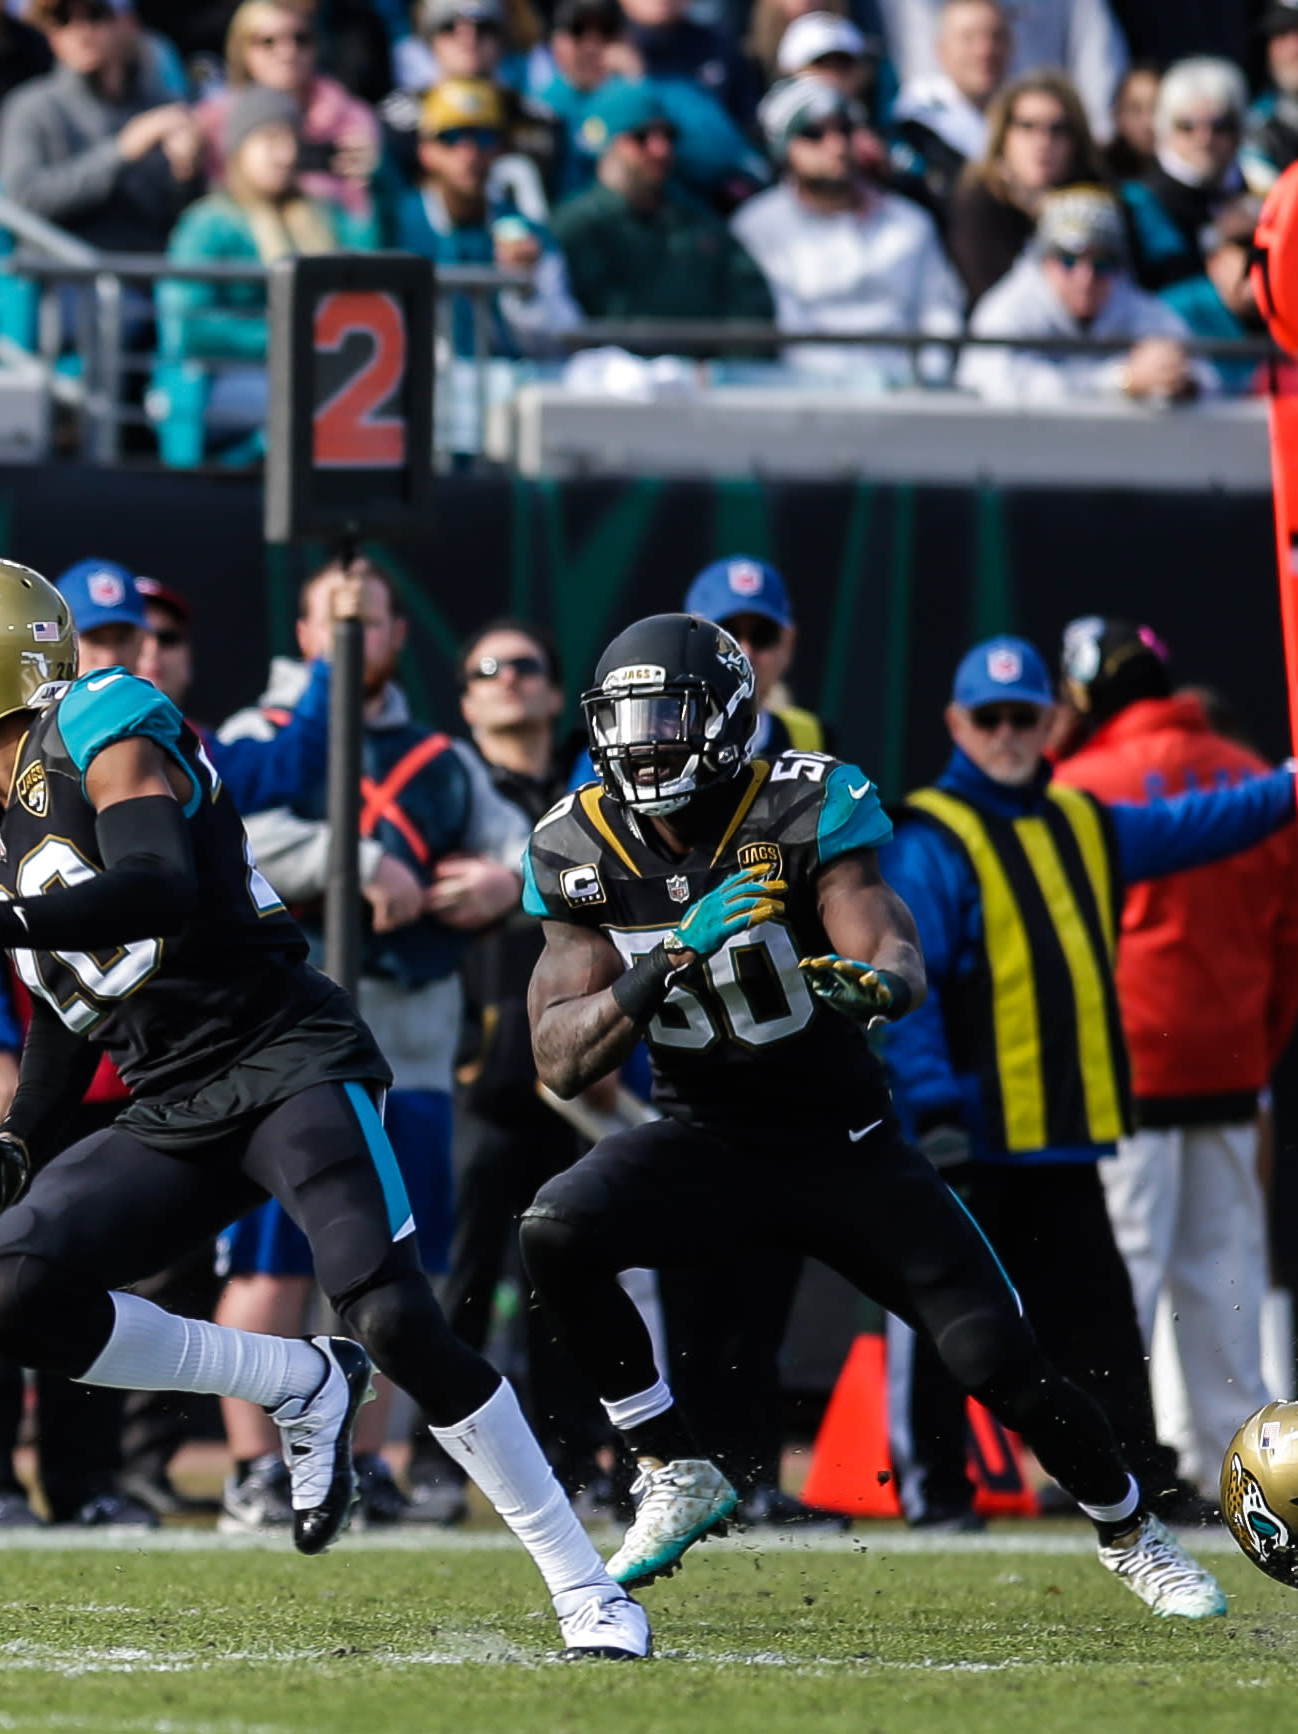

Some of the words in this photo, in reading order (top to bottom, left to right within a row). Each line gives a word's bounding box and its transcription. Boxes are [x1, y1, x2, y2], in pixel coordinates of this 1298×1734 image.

[313, 291, 406, 468] 2
[621, 668, 651, 680] JAGS
[741, 845, 777, 865] JAGS
[564, 867, 600, 898] C
[602, 918, 814, 1049] 50
